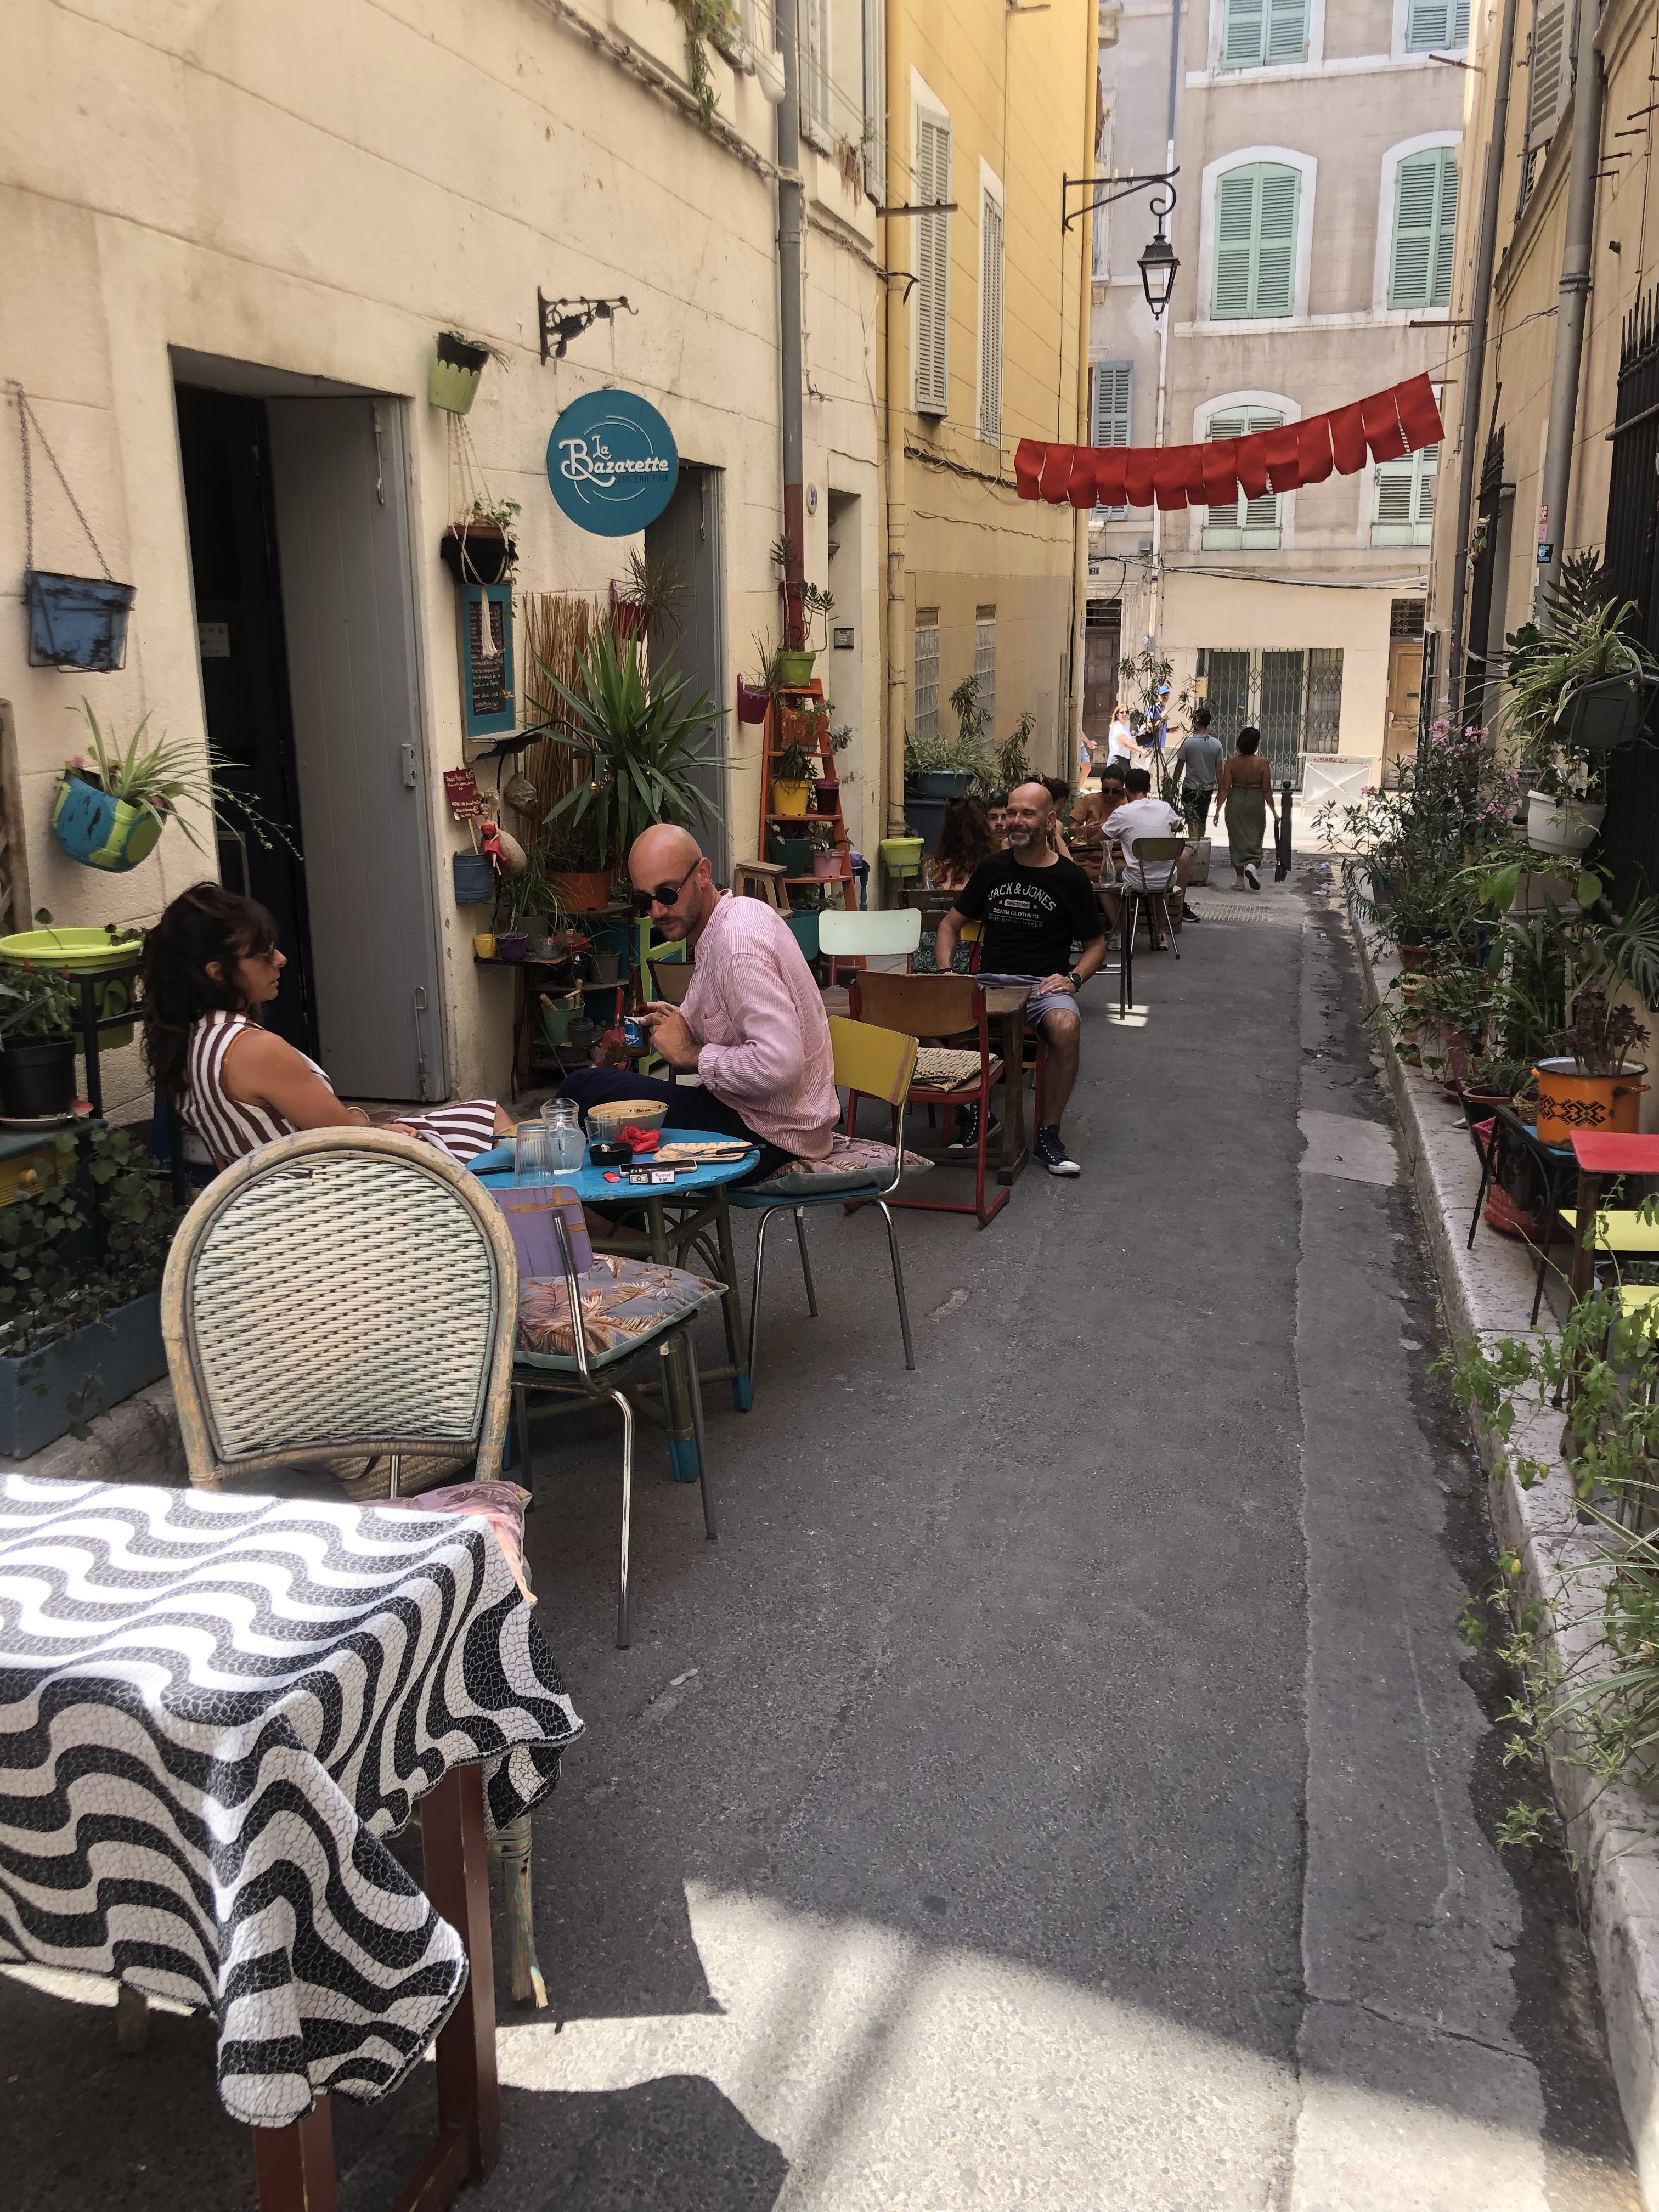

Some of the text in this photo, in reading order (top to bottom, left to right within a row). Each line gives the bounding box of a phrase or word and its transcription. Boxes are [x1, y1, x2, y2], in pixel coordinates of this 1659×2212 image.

[591, 435, 612, 460] La
[558, 439, 670, 488] Bazarette
[618, 474, 670, 483] EPICERIE FINE
[988, 883, 1057, 911] JACK & JONES
